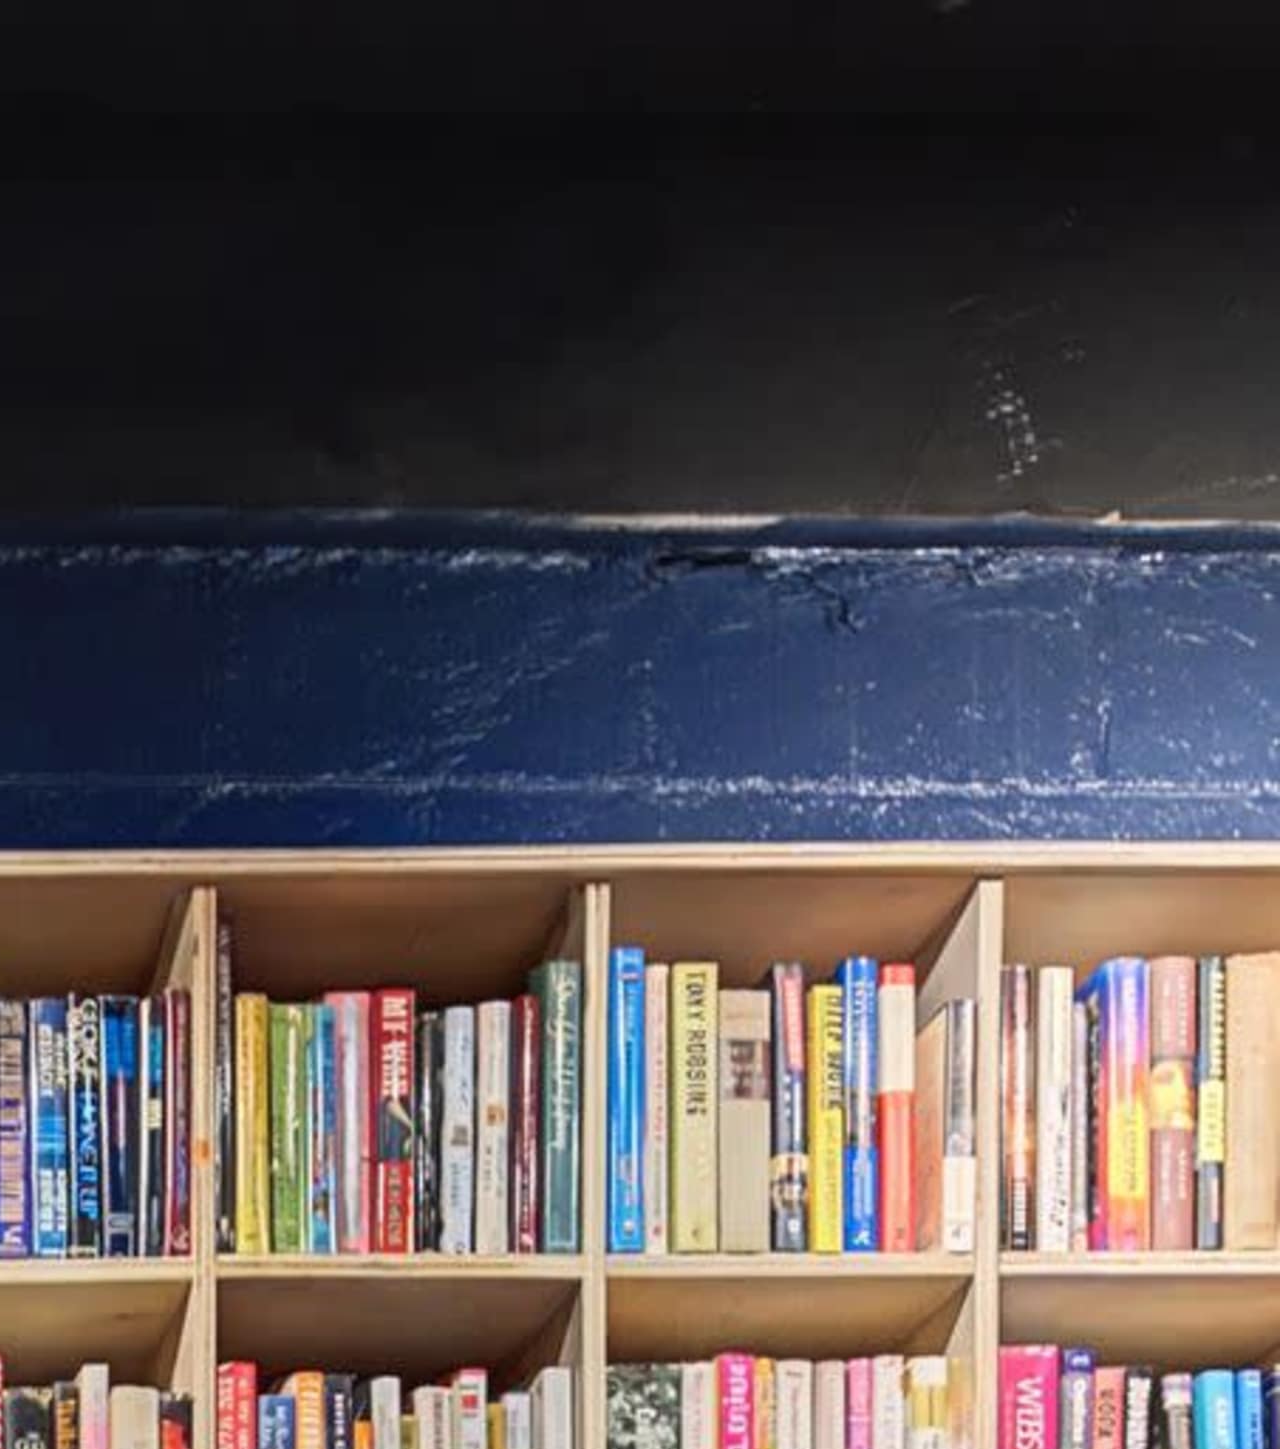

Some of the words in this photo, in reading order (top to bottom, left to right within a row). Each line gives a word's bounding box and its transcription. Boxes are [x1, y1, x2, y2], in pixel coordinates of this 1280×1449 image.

[381, 996, 408, 1036] MY
[686, 971, 708, 1023] TONY
[686, 1029, 708, 1117] ROBBINS
